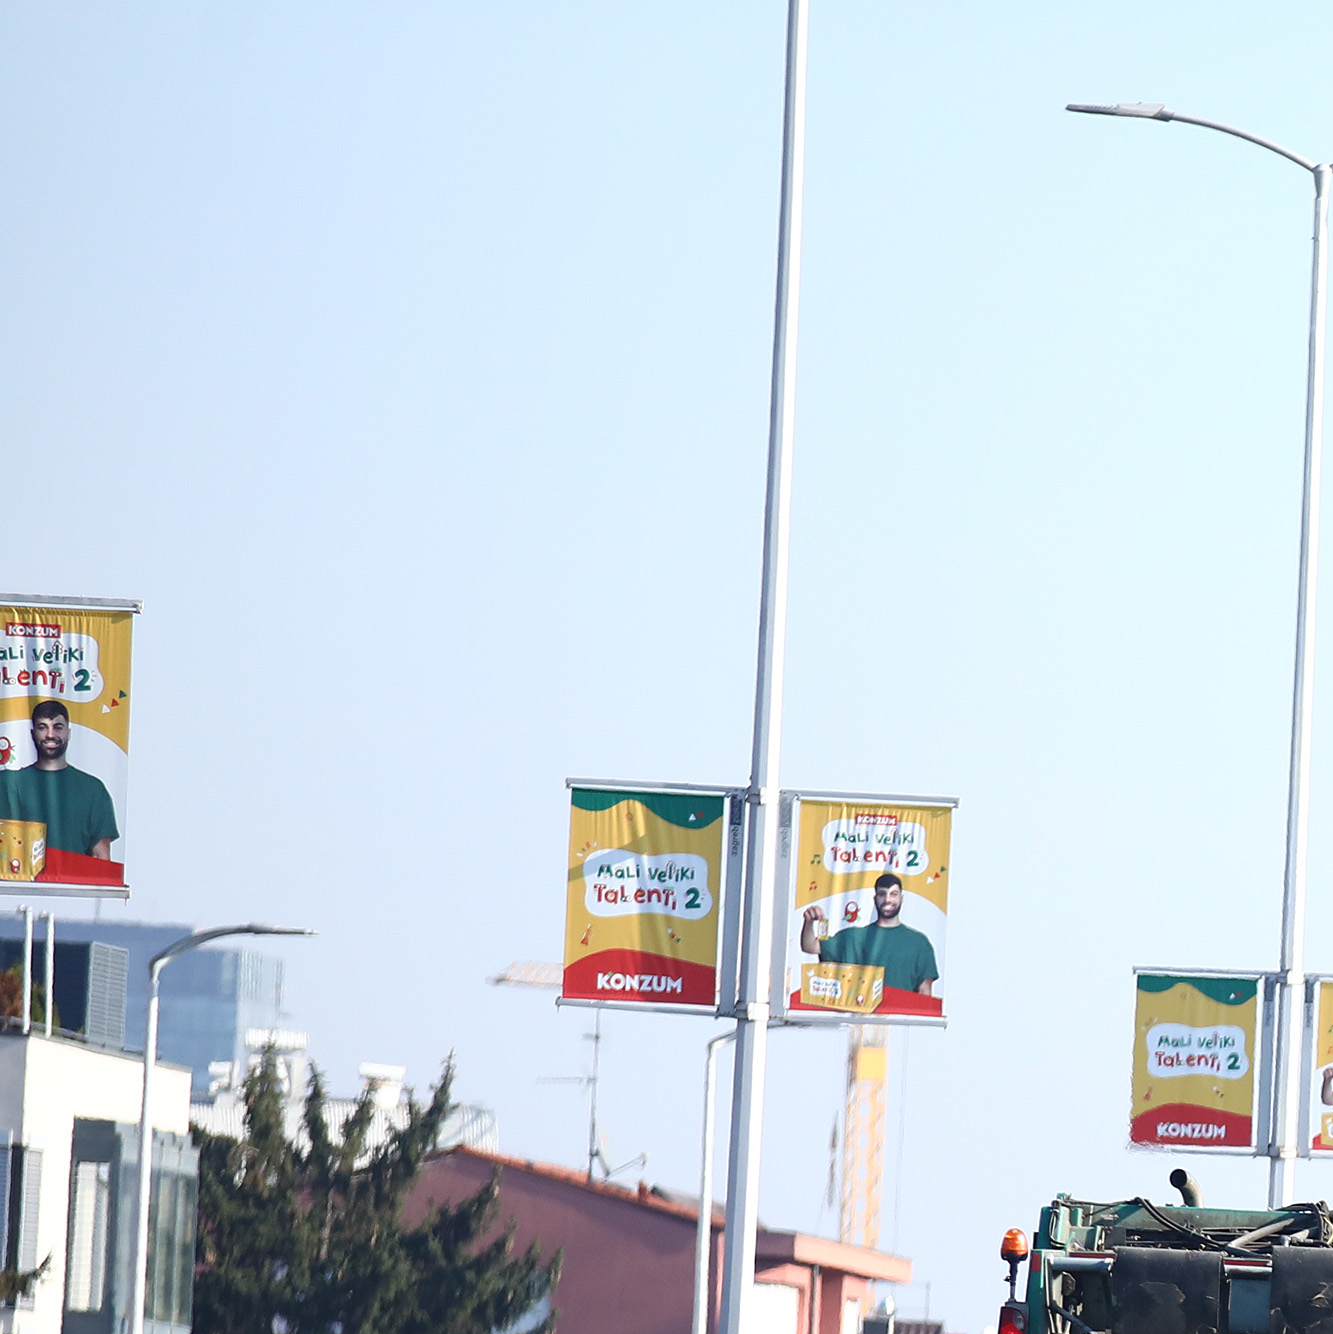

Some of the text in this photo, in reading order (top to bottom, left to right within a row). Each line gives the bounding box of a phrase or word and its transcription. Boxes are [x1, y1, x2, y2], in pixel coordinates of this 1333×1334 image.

[8, 625, 58, 637] KONZUM
[73, 669, 92, 692] 2
[906, 850, 920, 867] 2
[684, 887, 702, 909] 2
[597, 972, 682, 993] KONZUM
[1227, 1052, 1241, 1070] 2
[1156, 1122, 1226, 1139] KONZUM
